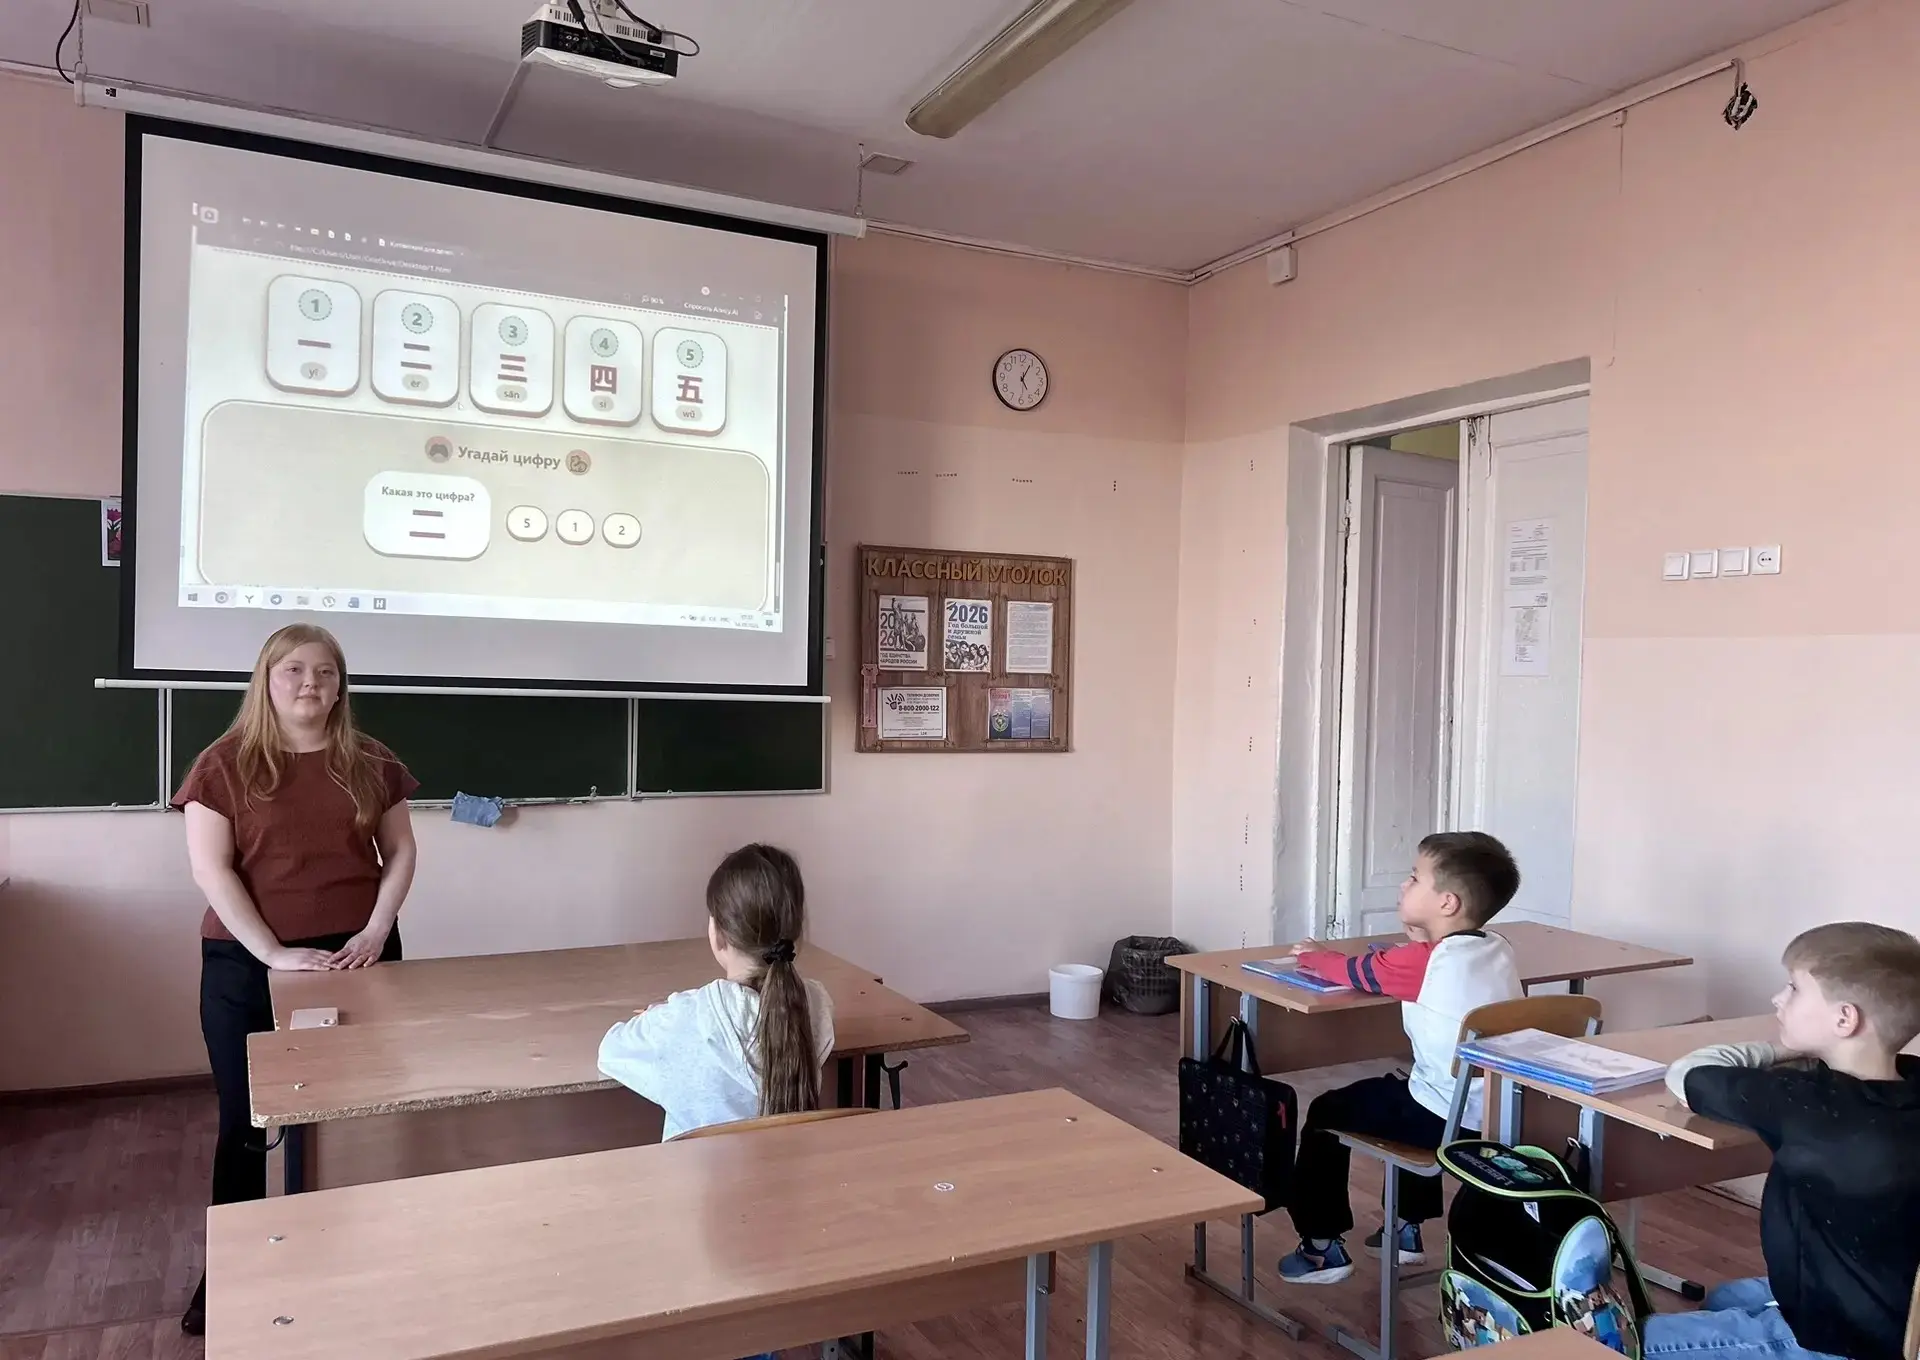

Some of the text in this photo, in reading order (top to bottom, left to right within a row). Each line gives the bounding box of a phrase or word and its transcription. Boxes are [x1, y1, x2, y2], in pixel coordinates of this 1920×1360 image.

[310, 298, 321, 313] 1
[411, 312, 423, 327] 2
[508, 325, 518, 339] 3
[599, 337, 609, 350] 4
[400, 342, 432, 371] 二
[685, 348, 695, 362] 5
[1010, 355, 1017, 365] 11
[1018, 354, 1027, 364] 12
[496, 353, 528, 383] 三
[1003, 362, 1012, 372] 10
[1030, 359, 1034, 367] 1
[1000, 372, 1006, 382] 9
[1035, 366, 1041, 376] 2
[590, 364, 618, 395] 四
[1037, 377, 1043, 387] 3
[676, 374, 704, 404] 五
[1002, 383, 1008, 392] 8
[1033, 388, 1040, 397] 4
[1009, 391, 1015, 401] 7
[1018, 395, 1025, 405] 6
[1027, 394, 1034, 403] 5
[458, 445, 561, 470] Угадай цифру
[381, 485, 475, 503] Какая это цифра?
[409, 509, 446, 539] 二
[523, 518, 531, 529] 5
[572, 522, 578, 533] 1
[618, 525, 626, 536] 2
[866, 557, 1067, 587] КЛАССНЫЙ УГОЛОК
[948, 604, 988, 624] 2026
[880, 612, 896, 630] 20
[960, 622, 989, 630] большой
[880, 630, 896, 647] 26
[1453, 1150, 1515, 1186] MINECRAFT
